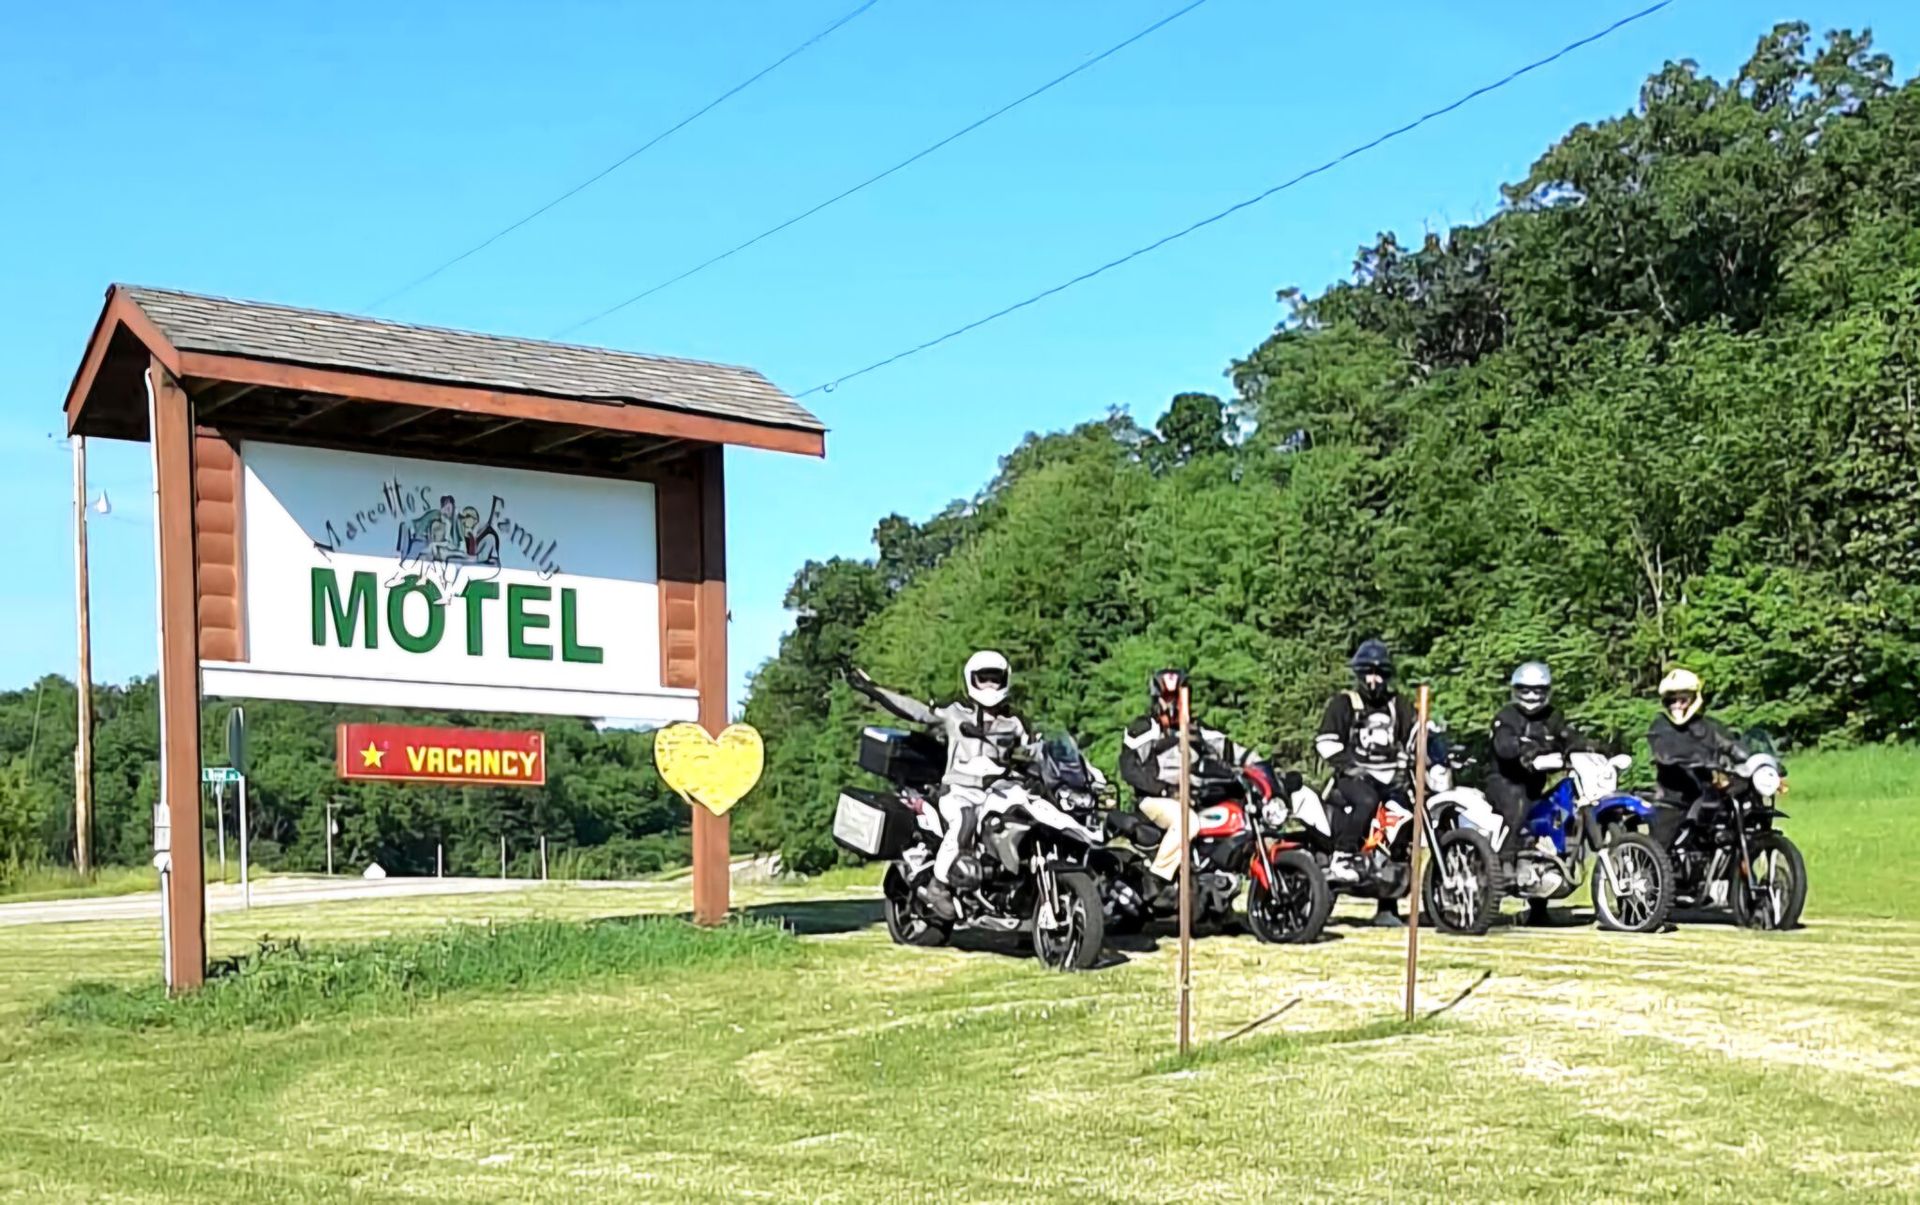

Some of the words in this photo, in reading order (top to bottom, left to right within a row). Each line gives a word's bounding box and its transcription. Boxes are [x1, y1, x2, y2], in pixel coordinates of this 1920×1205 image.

[487, 494, 561, 581] Family
[311, 566, 604, 664] MOTEL
[406, 745, 538, 777] VACANCY
